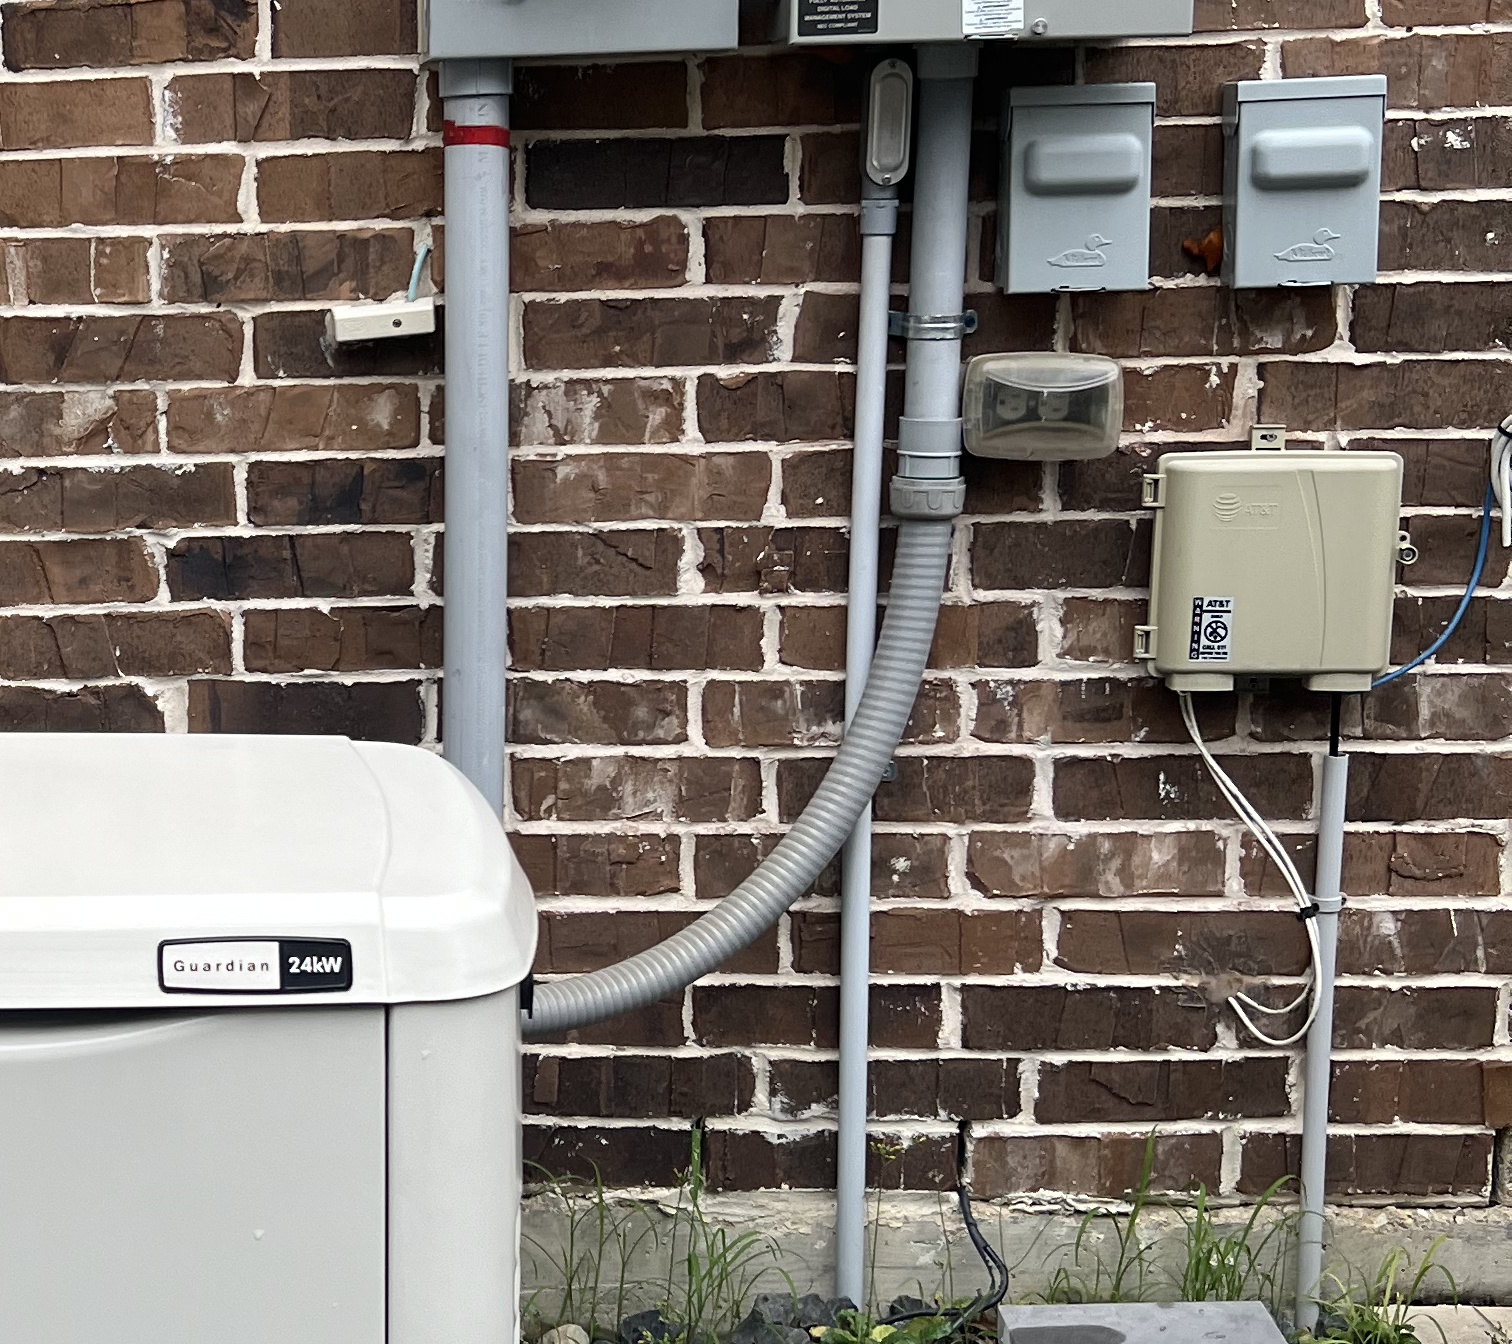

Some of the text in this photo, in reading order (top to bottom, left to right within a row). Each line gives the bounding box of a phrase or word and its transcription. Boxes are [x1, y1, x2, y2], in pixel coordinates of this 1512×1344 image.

[1205, 599, 1231, 608] AT&T
[1190, 598, 1203, 659] WARNING
[173, 956, 343, 974] Guardian 24kW
